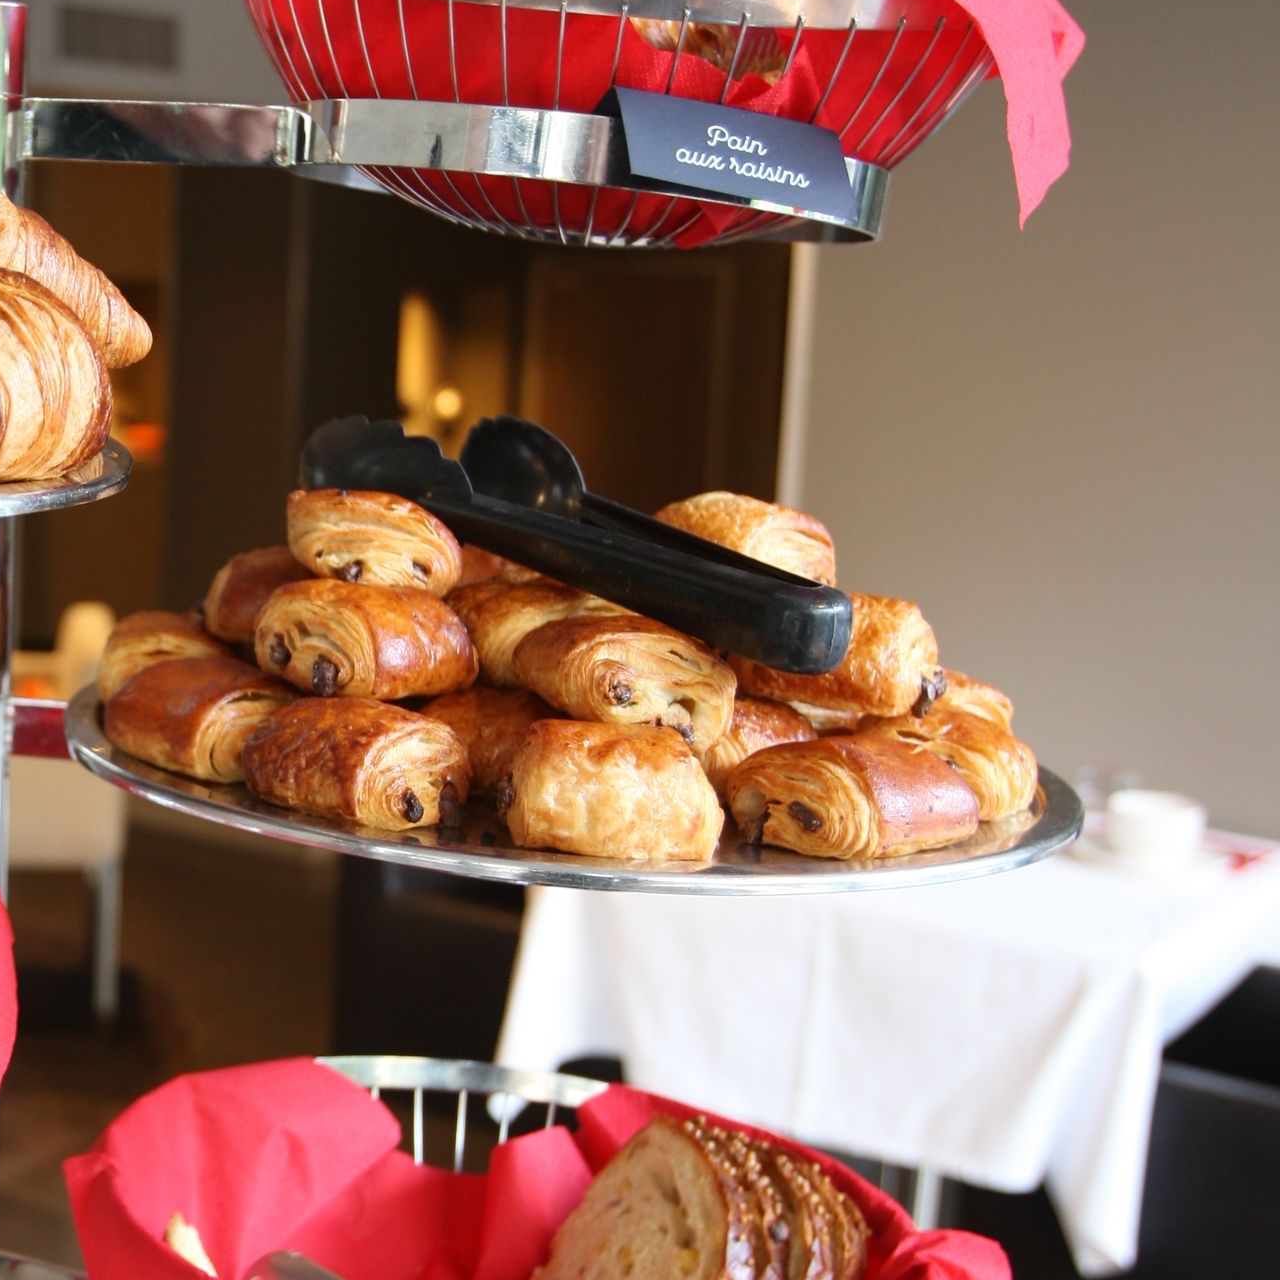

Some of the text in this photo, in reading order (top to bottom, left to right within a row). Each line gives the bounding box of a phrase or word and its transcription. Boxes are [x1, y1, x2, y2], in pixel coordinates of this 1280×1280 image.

[706, 125, 767, 156] Pain
[675, 147, 810, 188] aux raisins
